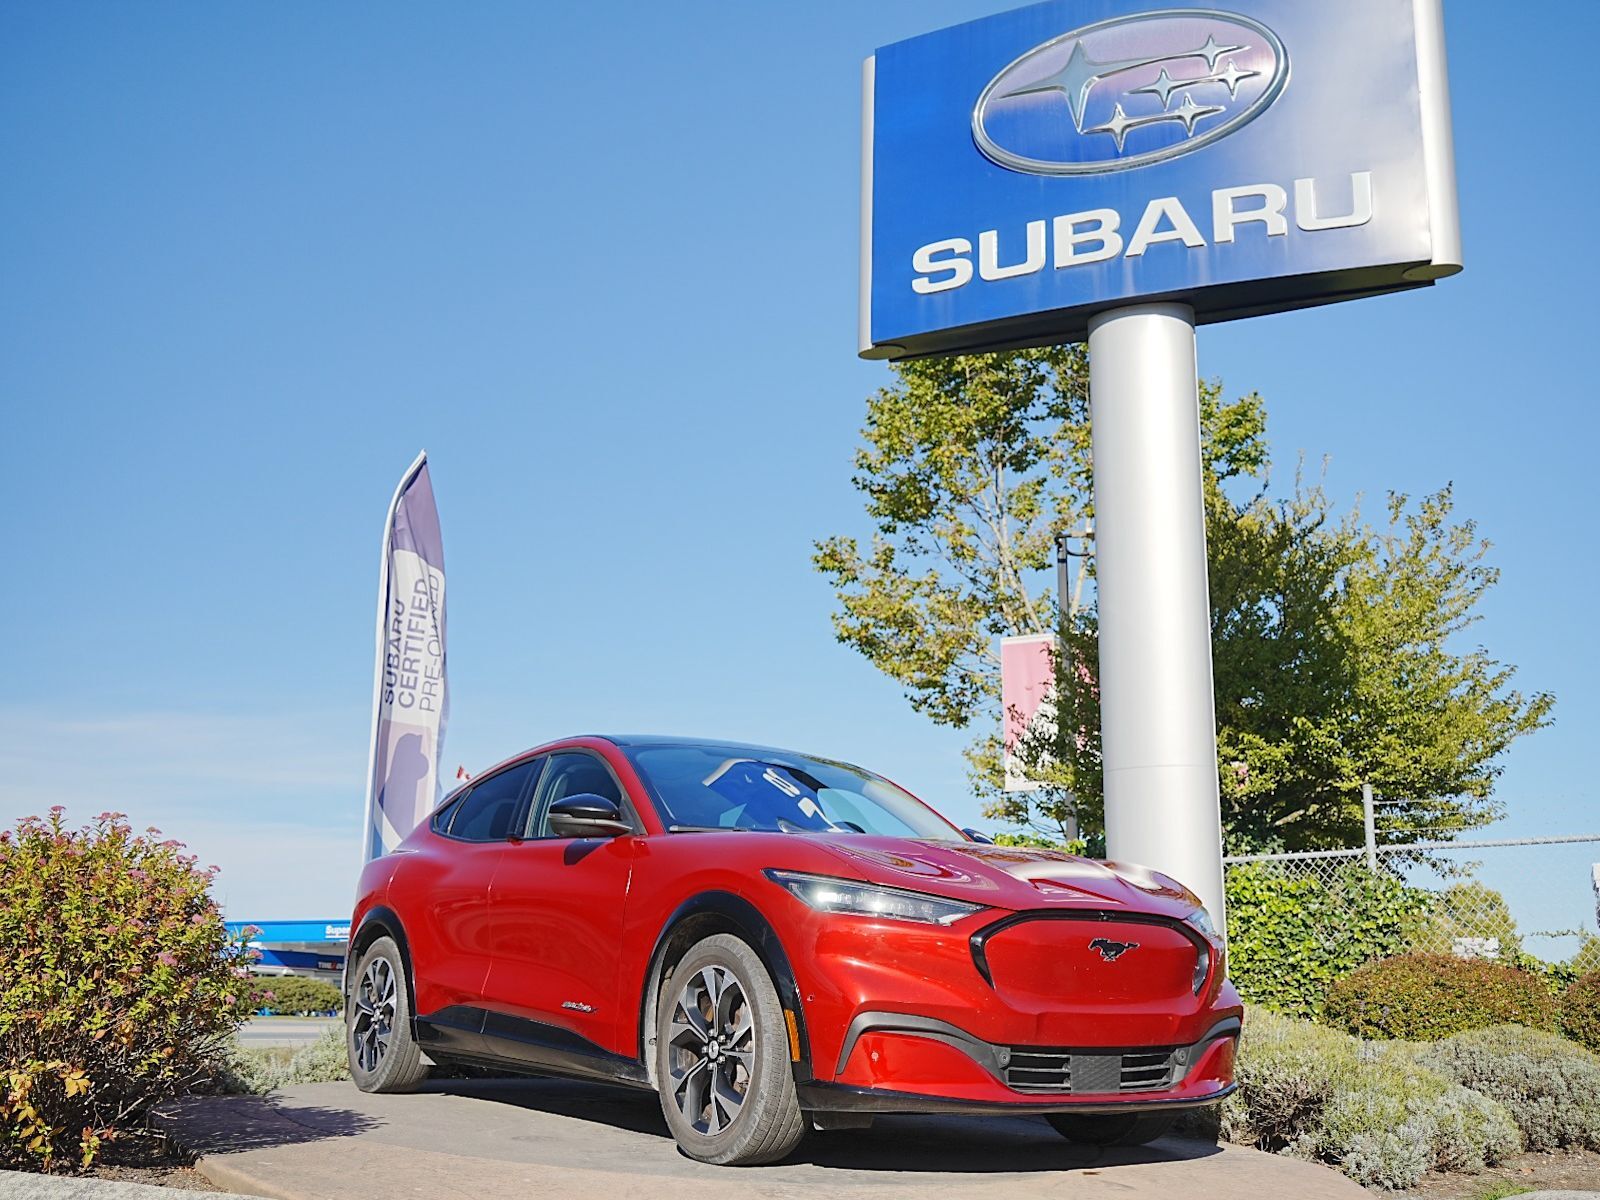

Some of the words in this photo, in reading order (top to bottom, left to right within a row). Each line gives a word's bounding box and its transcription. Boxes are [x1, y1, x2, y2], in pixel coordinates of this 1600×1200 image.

[911, 171, 1373, 294] SUBARU
[385, 598, 405, 705] SUBARU
[398, 578, 429, 709] CERTIFIED
